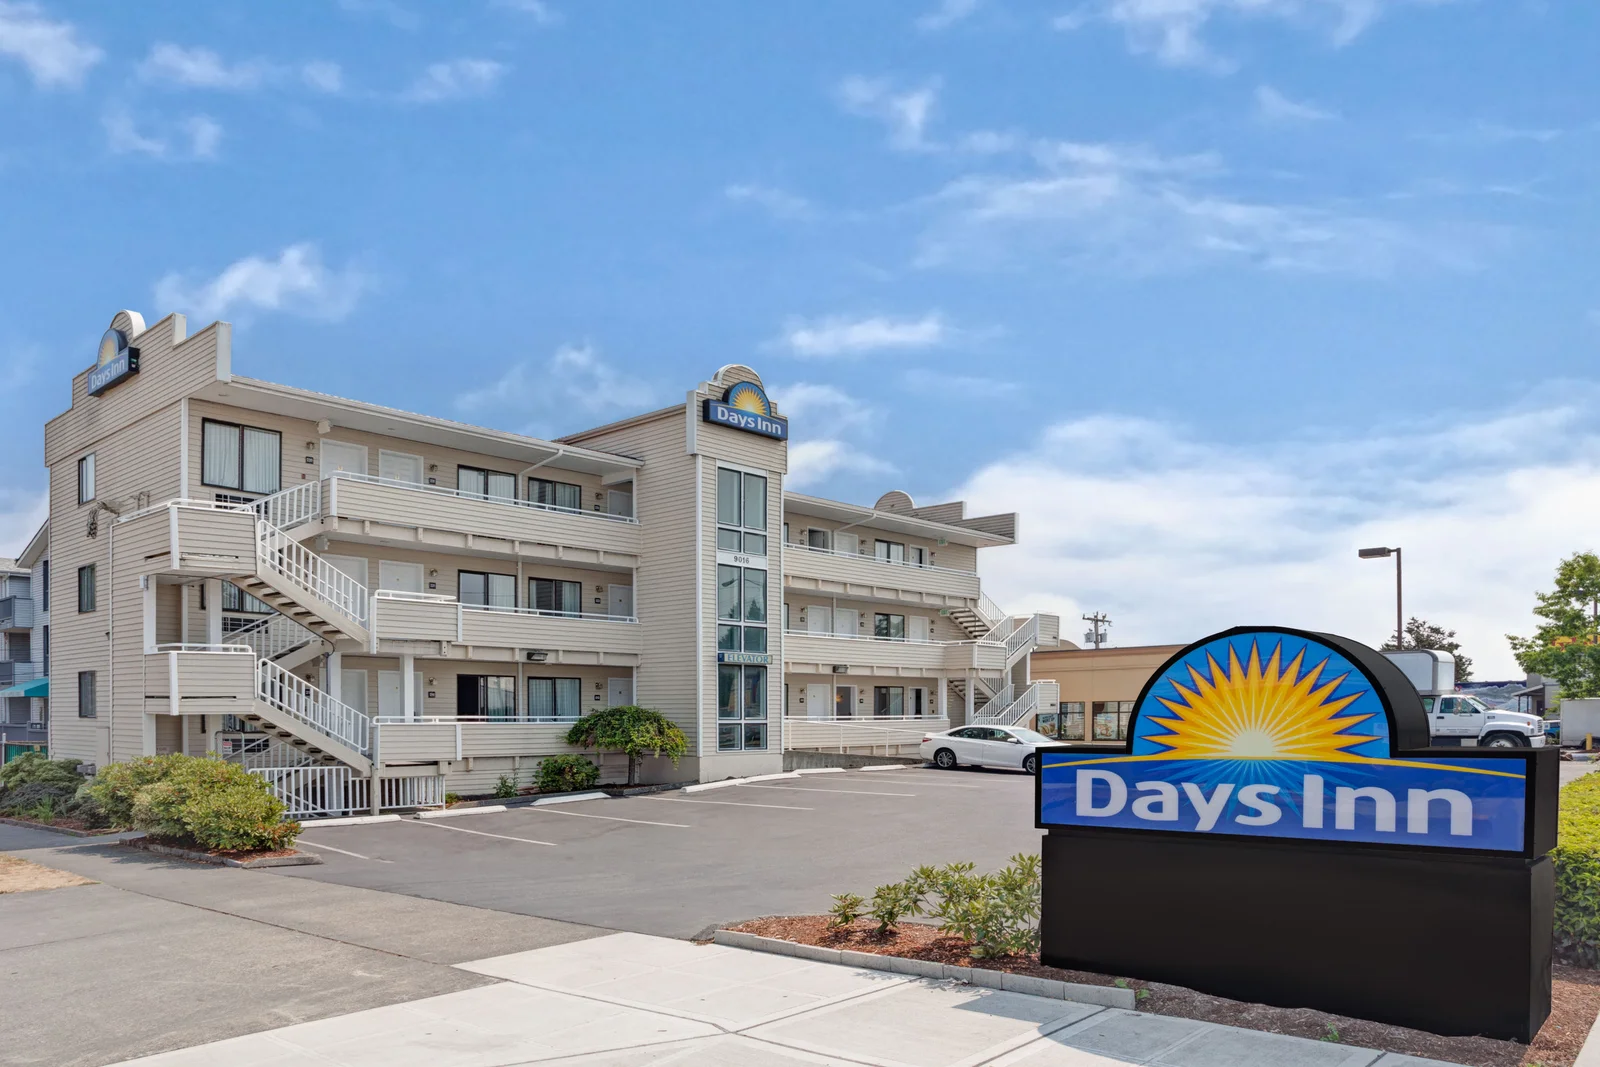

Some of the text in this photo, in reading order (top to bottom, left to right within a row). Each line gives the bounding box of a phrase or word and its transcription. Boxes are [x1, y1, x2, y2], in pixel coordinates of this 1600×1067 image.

[91, 359, 125, 389] Days Inn
[717, 406, 782, 435] Days Inn
[733, 555, 750, 564] 9016
[727, 653, 769, 664] ELEVATOR
[1076, 768, 1473, 836] Days Inn
